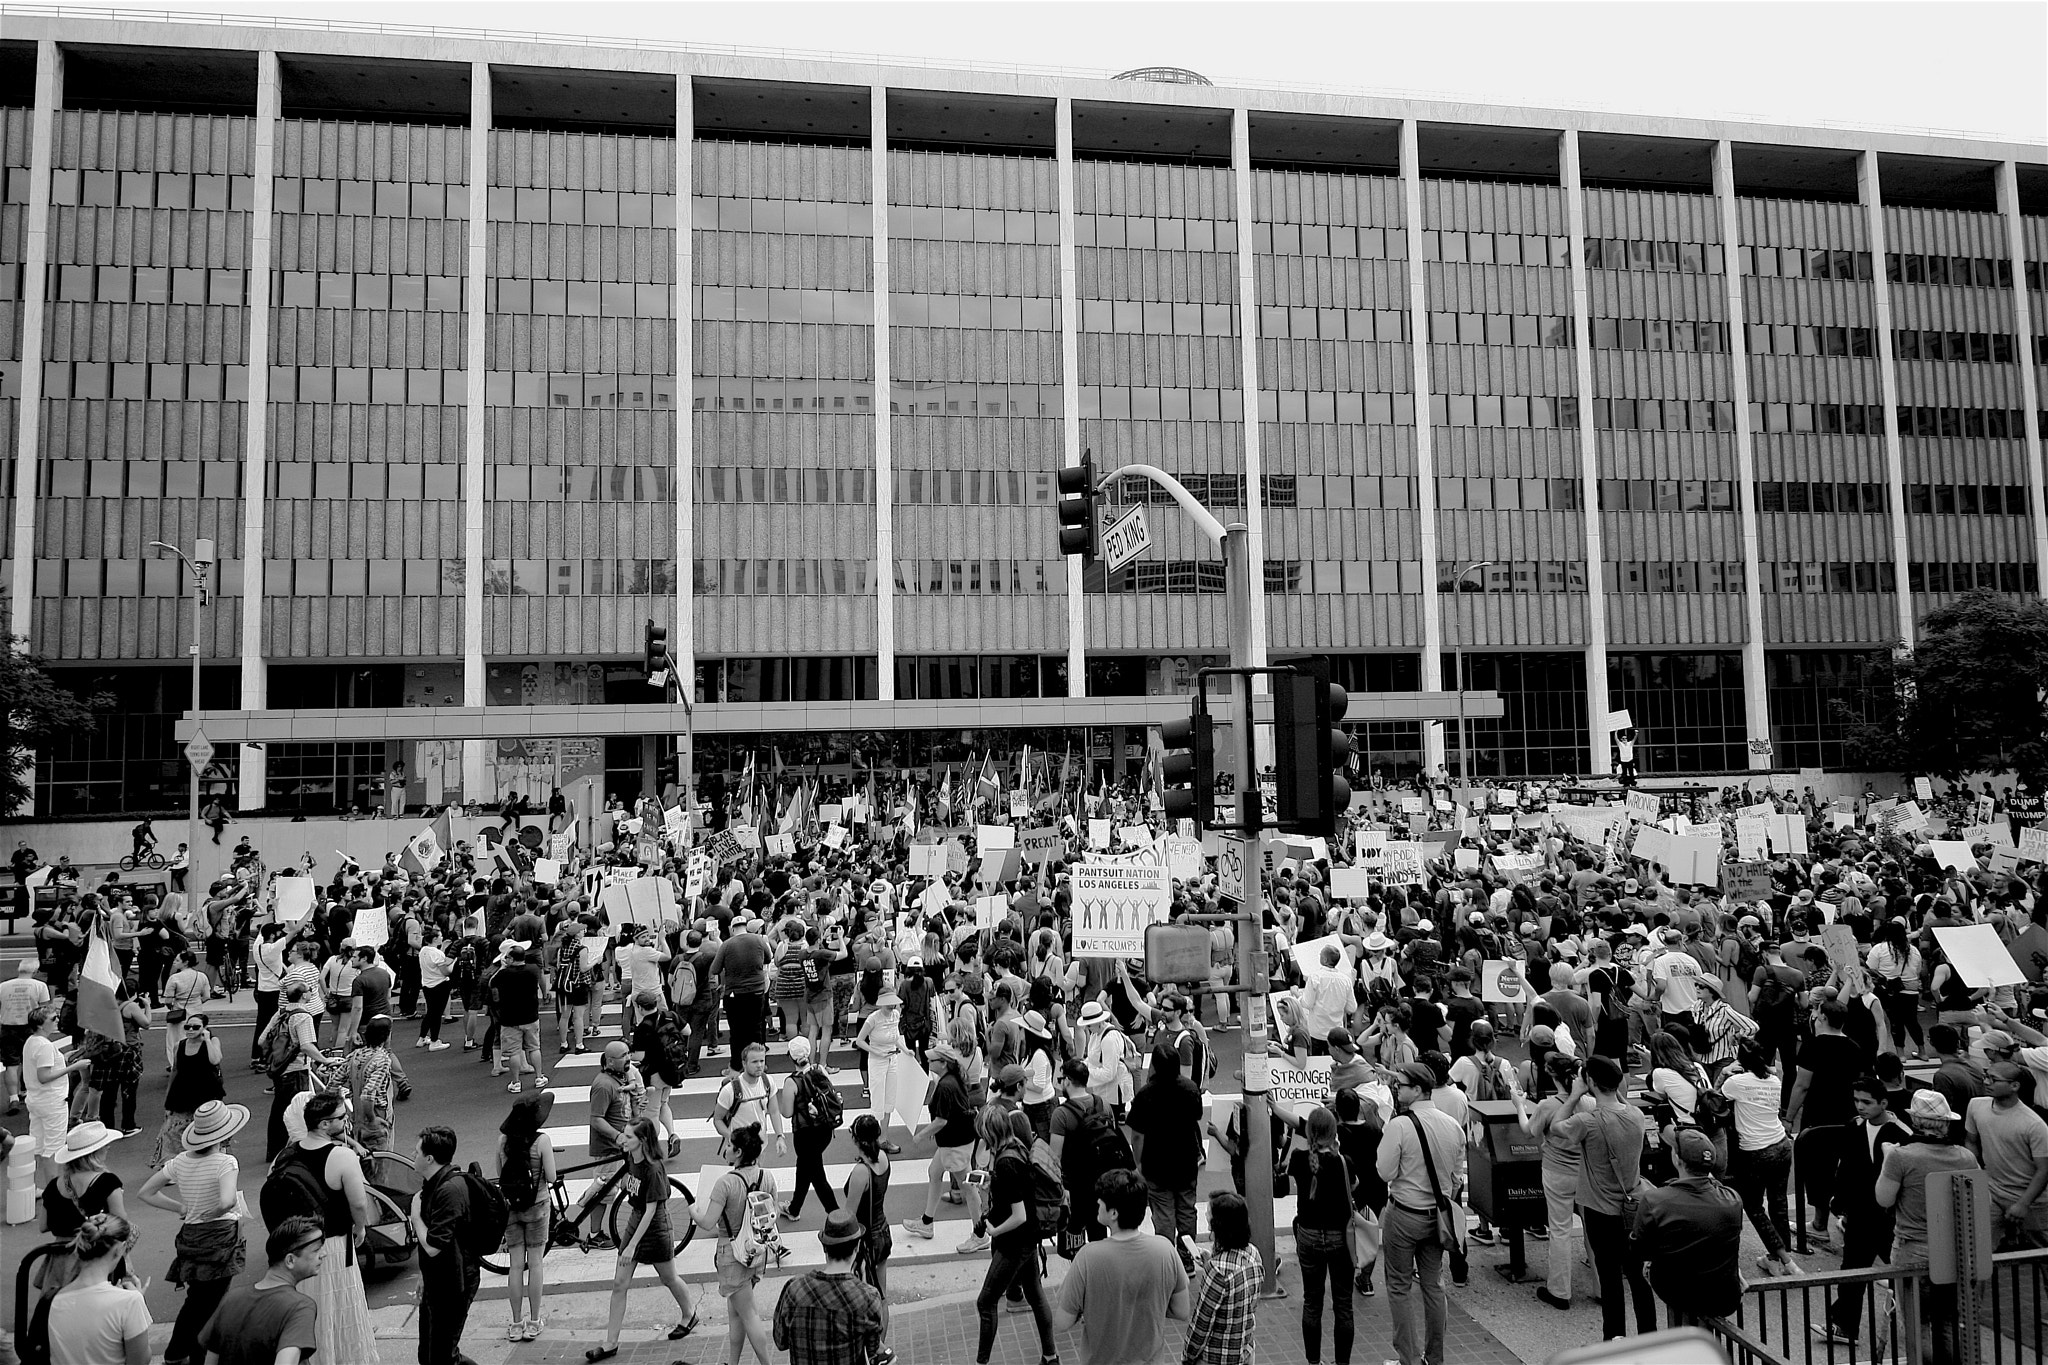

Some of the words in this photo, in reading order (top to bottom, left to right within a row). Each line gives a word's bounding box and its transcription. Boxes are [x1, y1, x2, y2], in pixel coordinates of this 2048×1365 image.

[1106, 532, 1124, 562] PED
[1122, 515, 1145, 551] XING
[1627, 793, 1659, 812] WRONG!
[2010, 798, 2039, 806] DUMP
[709, 829, 734, 846] BLACK
[1965, 827, 1989, 838] ILLEGAL
[1023, 834, 1059, 851] PREXIT
[1361, 833, 1380, 847] MY
[714, 839, 737, 854] LIVES
[1361, 847, 1382, 859] BODY
[1393, 849, 1416, 861] BODY
[1394, 860, 1419, 872] RULES
[1728, 866, 1743, 878] NO
[1745, 863, 1769, 877] HATE
[613, 869, 634, 877] MAKE
[1079, 868, 1124, 878] PANTSUIT
[1125, 869, 1160, 879] NATION
[1079, 880, 1097, 889] LOS
[1098, 880, 1140, 890] ANGELES
[1727, 880, 1737, 888] in
[1737, 878, 1754, 887] the
[1231, 884, 1243, 898] LANE
[1102, 939, 1137, 951] TRUMPS
[1499, 982, 1520, 990] Trump
[1271, 1068, 1331, 1085] STRONGER
[1271, 1087, 1329, 1102] TOGETHER
[1508, 1188, 1526, 1196] Daily
